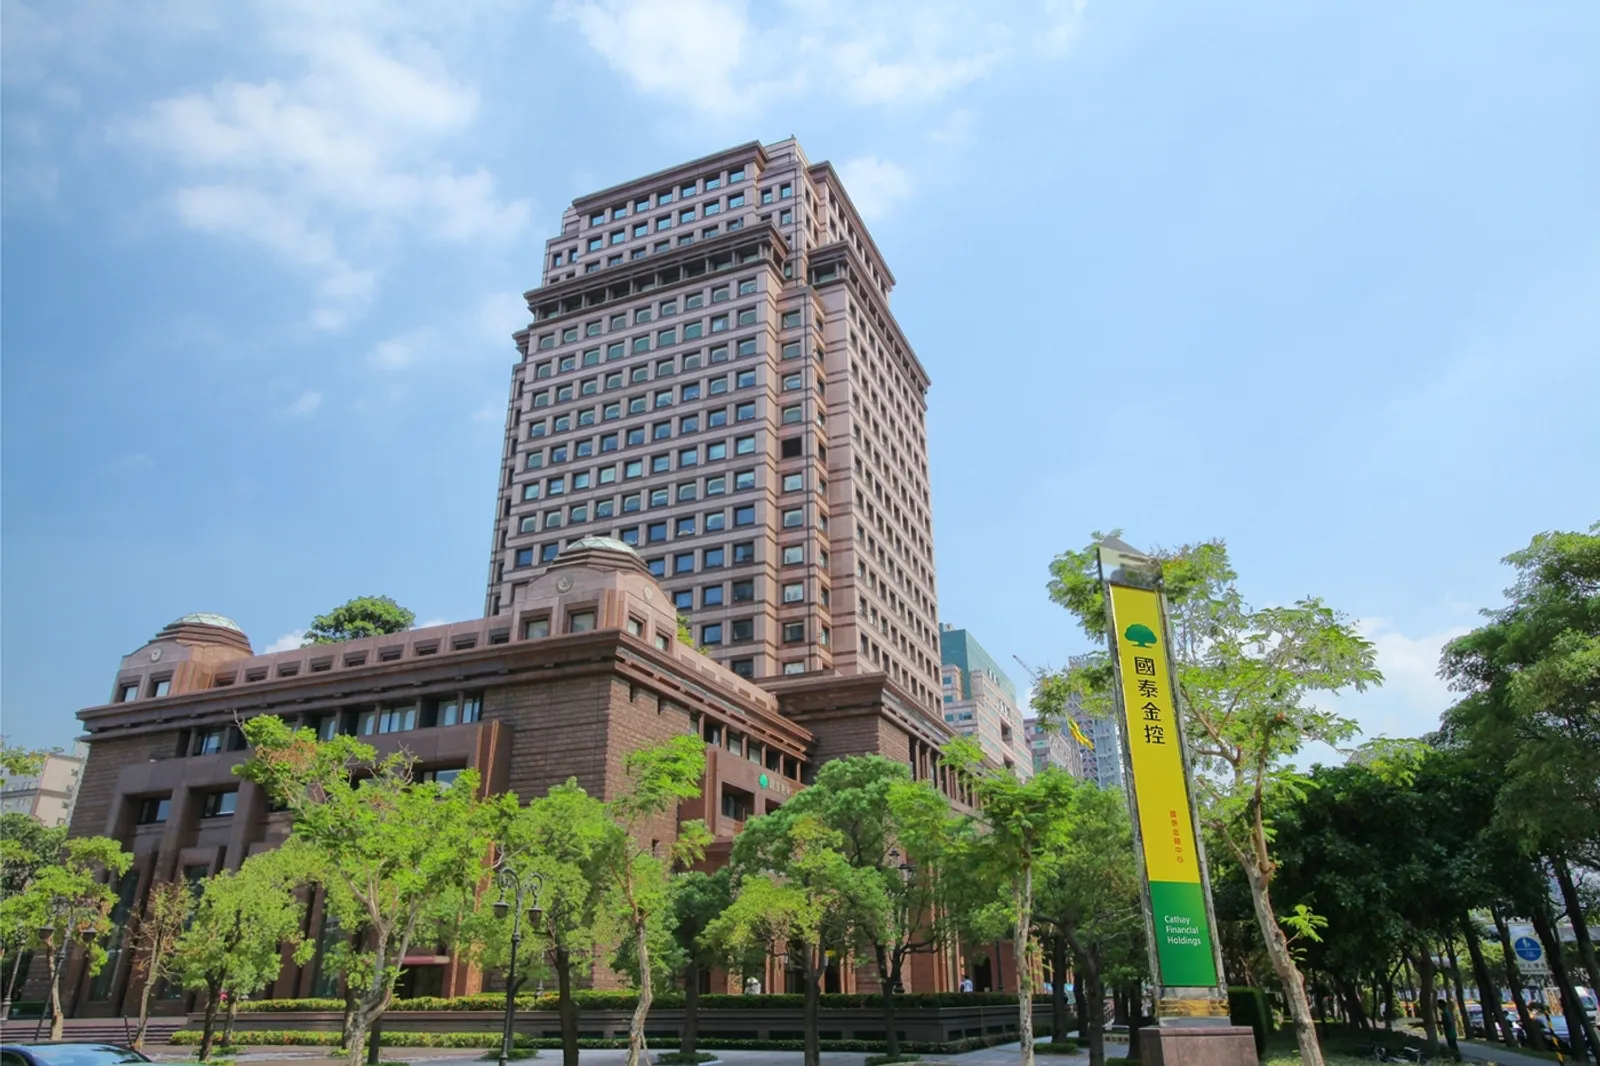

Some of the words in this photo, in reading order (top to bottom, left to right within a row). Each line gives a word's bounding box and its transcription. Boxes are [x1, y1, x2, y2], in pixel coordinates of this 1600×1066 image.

[1134, 656, 1166, 745] 國泰金控
[1164, 915, 1190, 925] Cathay
[1165, 925, 1199, 934] Financial
[1167, 936, 1201, 947] Holdings
